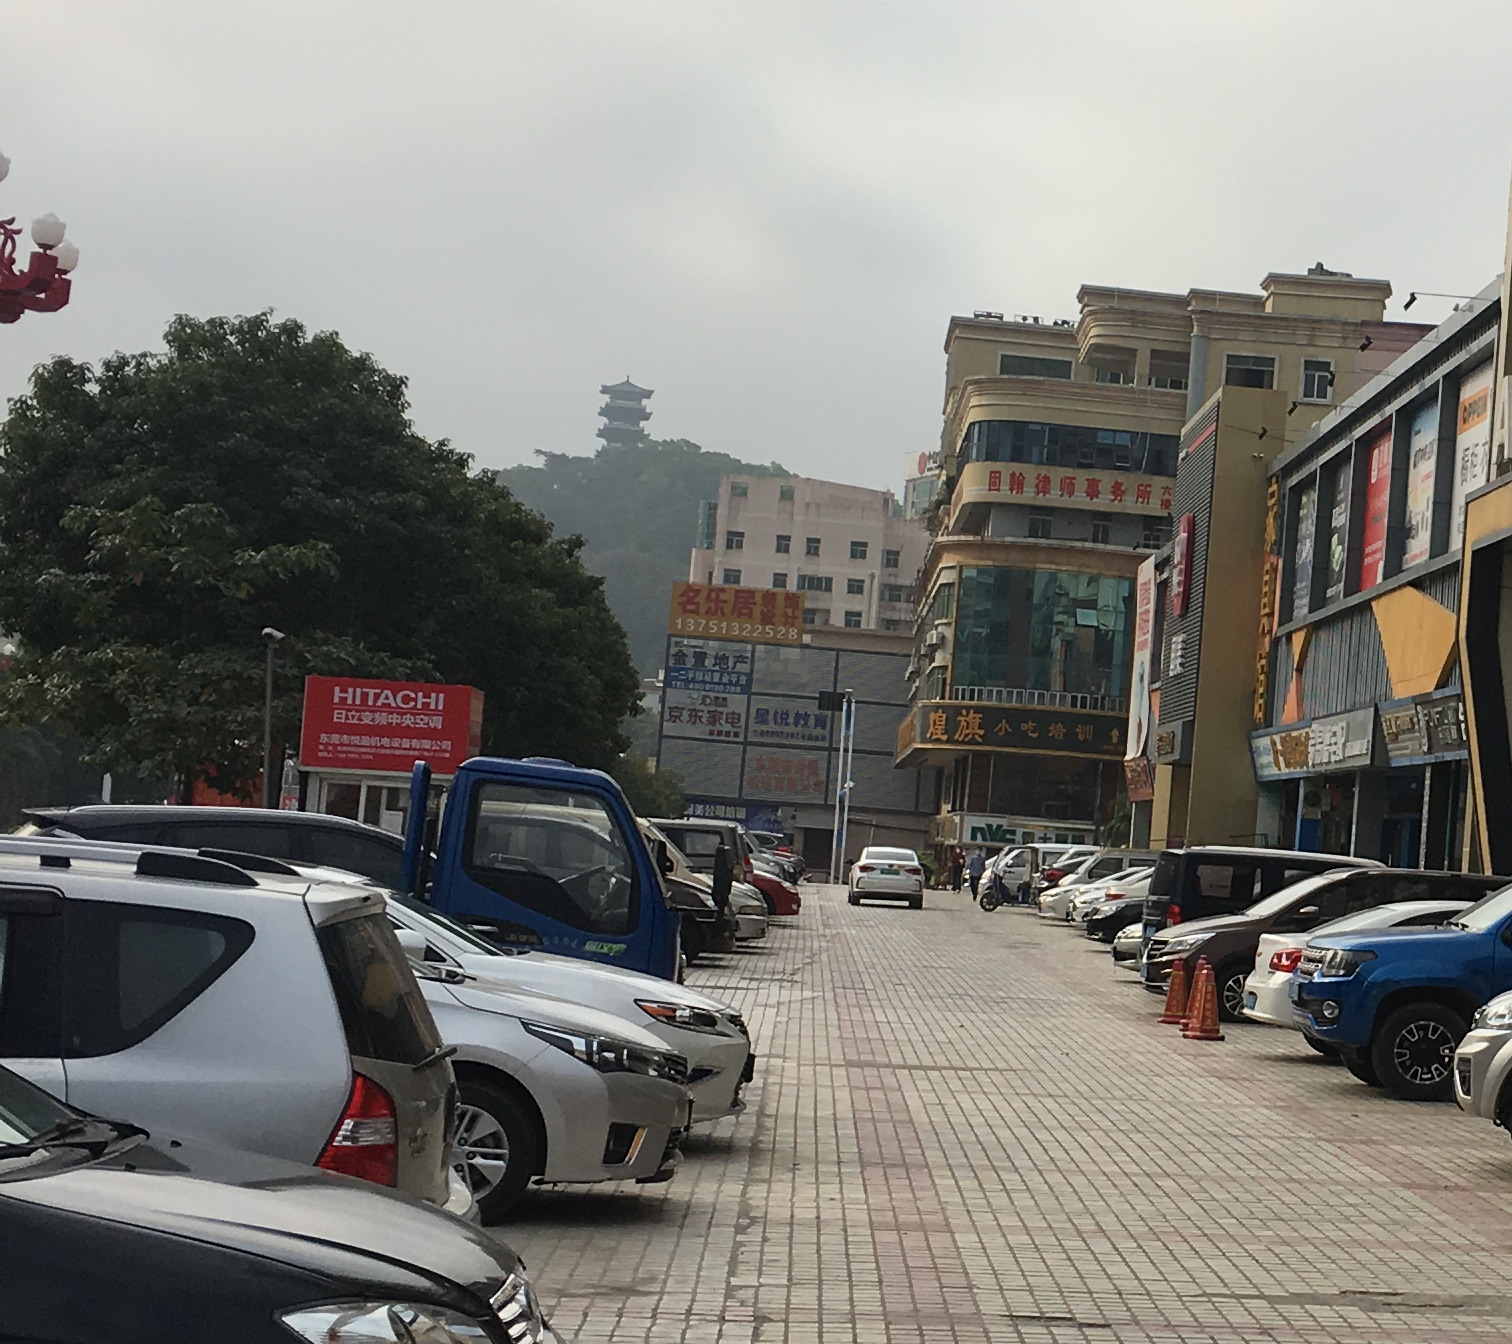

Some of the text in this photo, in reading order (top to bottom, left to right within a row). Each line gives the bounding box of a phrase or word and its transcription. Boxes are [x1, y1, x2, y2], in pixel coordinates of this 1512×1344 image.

[678, 585, 757, 620] 名乐居
[675, 618, 799, 640] 13751322528
[333, 686, 445, 711] HITACHI
[333, 709, 443, 730] 日立变频中央空调
[664, 706, 742, 731] 京东家电
[993, 719, 1094, 743] 小吃培训
